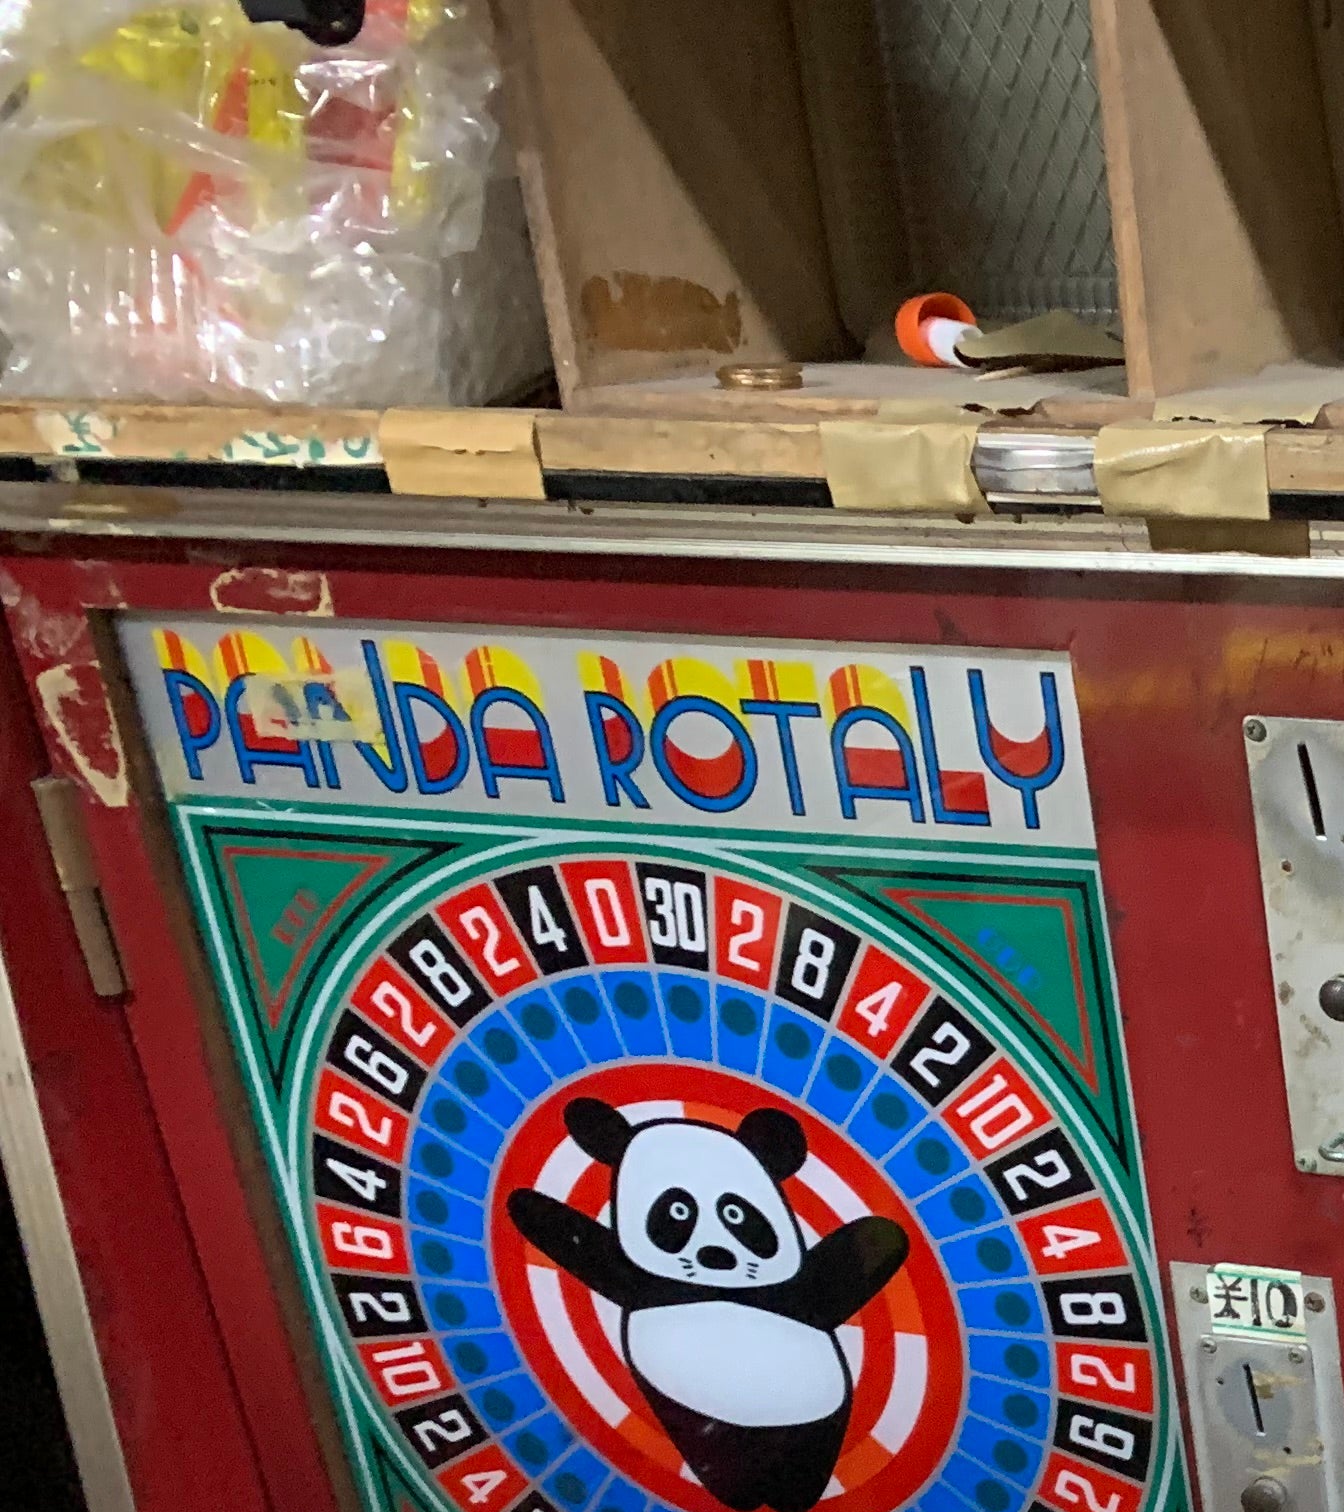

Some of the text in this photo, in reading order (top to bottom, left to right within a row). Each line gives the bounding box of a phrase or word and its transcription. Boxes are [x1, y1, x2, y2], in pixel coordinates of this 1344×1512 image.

[152, 625, 1066, 831] PANDA ROTALY
[529, 884, 568, 953] 4
[586, 878, 629, 946] 0
[646, 878, 705, 952] 30
[728, 899, 764, 971] 2
[460, 905, 519, 977] 2
[792, 928, 834, 999] 8
[409, 939, 472, 1007] 8
[371, 981, 437, 1047] 2
[856, 981, 902, 1036] 4
[344, 1034, 409, 1094] 6
[910, 1021, 970, 1088] 2
[329, 1091, 392, 1145] 2
[956, 1074, 1033, 1149] 10
[326, 1157, 386, 1200] 4
[1003, 1149, 1071, 1200] 2
[333, 1222, 393, 1259] 6
[1040, 1223, 1101, 1259] 4
[350, 1292, 411, 1323] 2
[1060, 1291, 1126, 1325] 8
[1213, 1274, 1298, 1328] ¥10
[372, 1342, 440, 1395] 10
[1071, 1353, 1135, 1392] 2
[413, 1410, 472, 1452] 2
[1070, 1413, 1134, 1460] 6
[460, 1469, 508, 1504] 4
